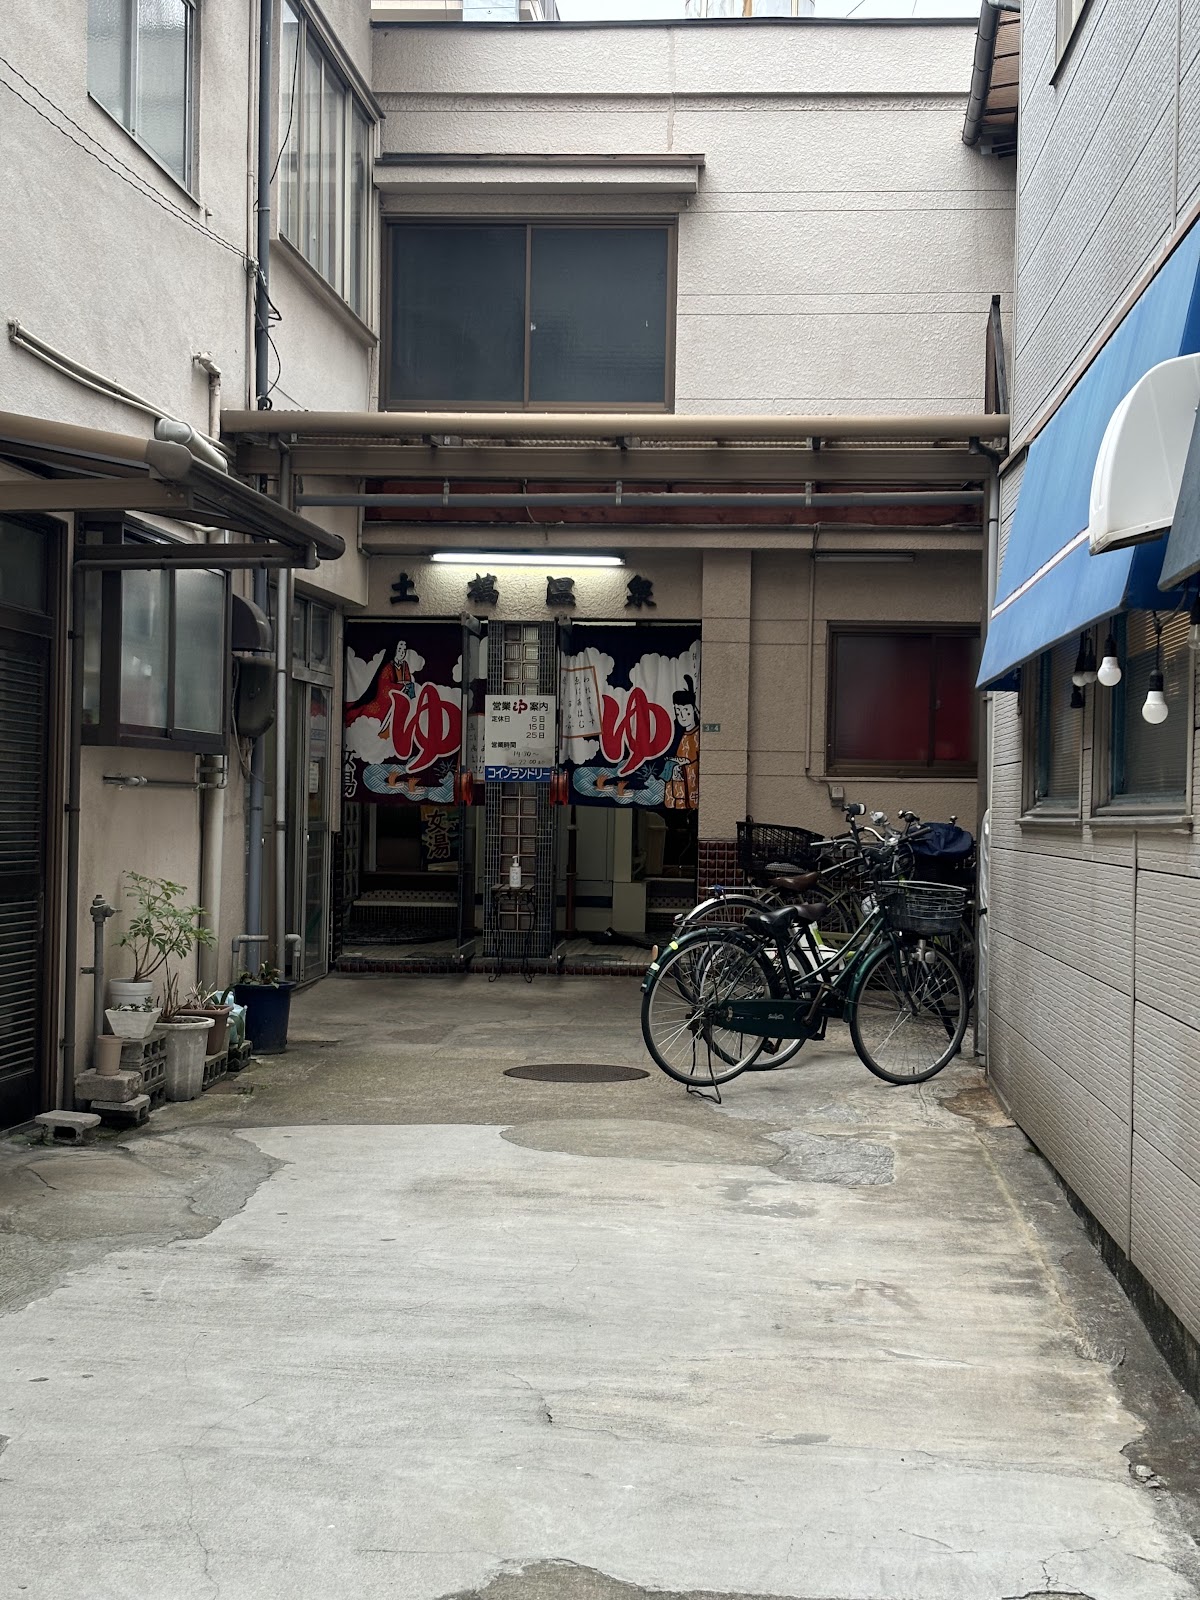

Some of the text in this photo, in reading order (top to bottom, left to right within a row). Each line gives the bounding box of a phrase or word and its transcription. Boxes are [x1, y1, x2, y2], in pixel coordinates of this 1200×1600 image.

[391, 684, 461, 773] ゆ
[491, 741, 517, 749] 営業時間
[602, 687, 672, 775] ゆ
[487, 767, 551, 780] コインランドリー
[427, 808, 451, 860] 女湯
